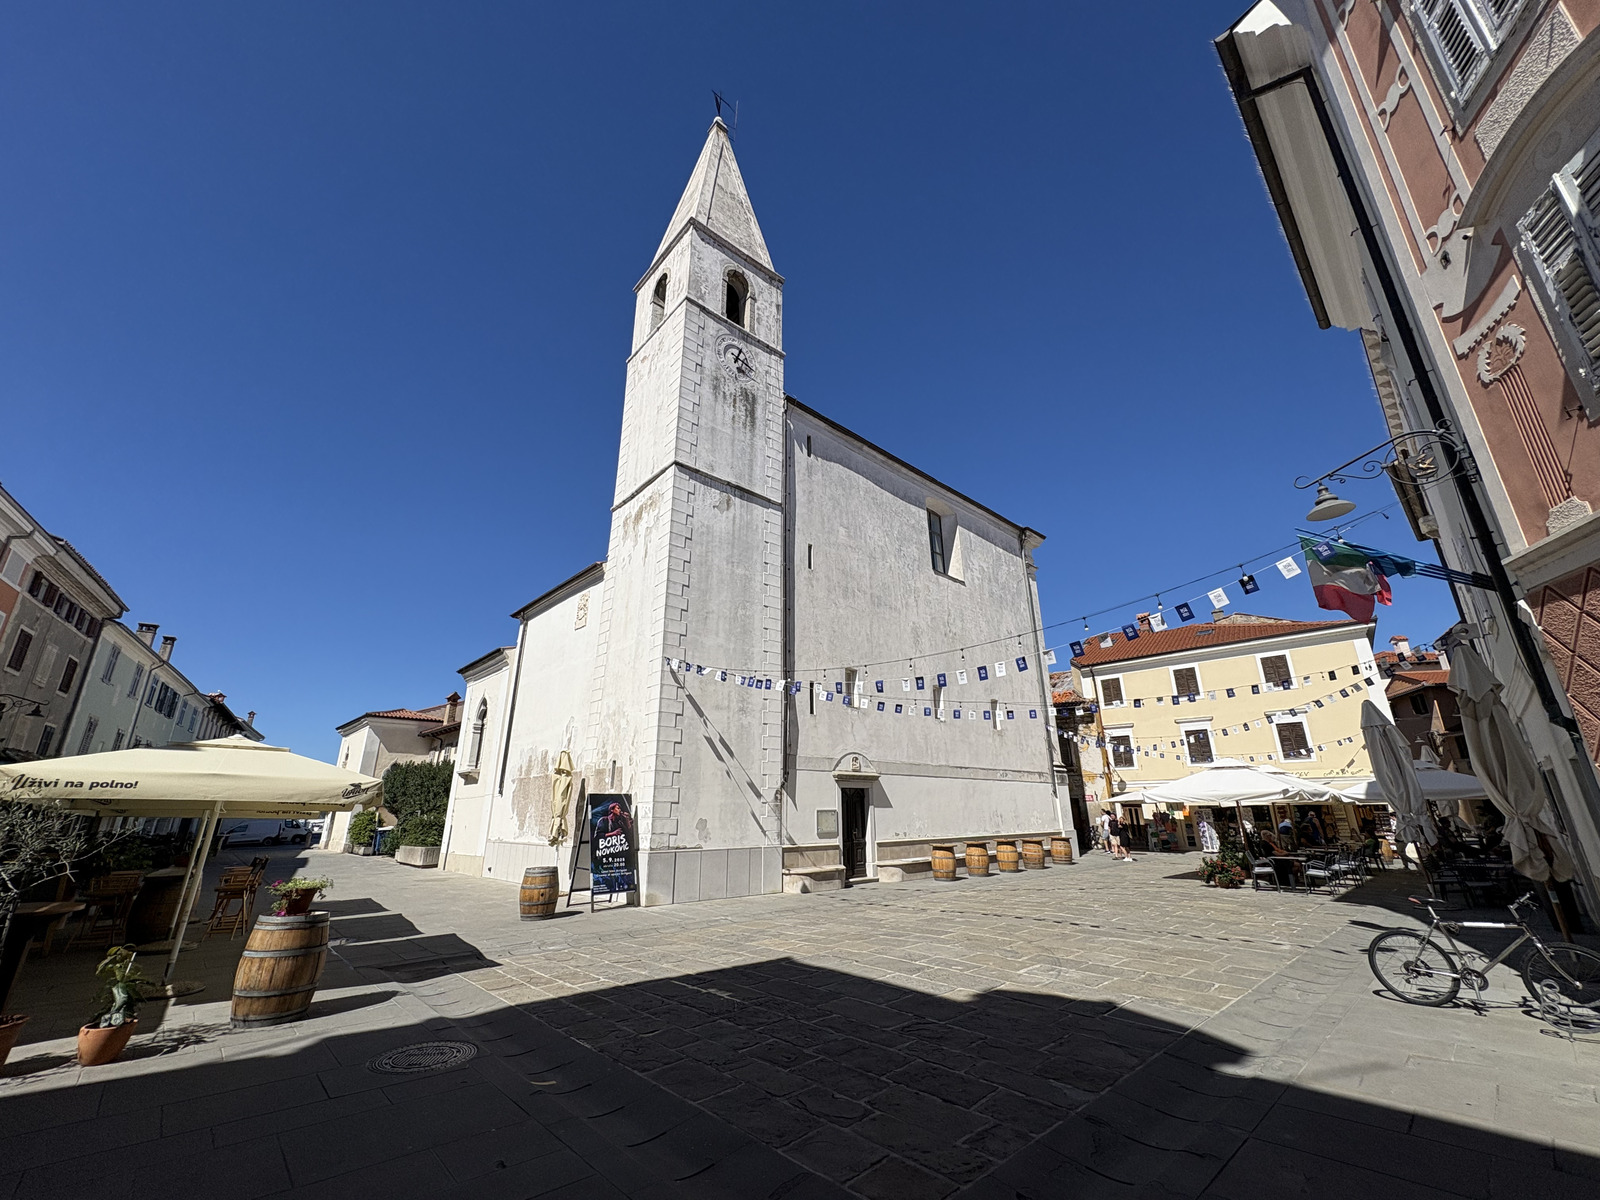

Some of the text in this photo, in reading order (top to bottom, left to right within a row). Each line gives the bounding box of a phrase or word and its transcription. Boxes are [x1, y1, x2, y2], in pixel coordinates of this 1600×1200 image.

[11, 774, 139, 790] Uživi na polno!
[599, 834, 626, 848] BORIS
